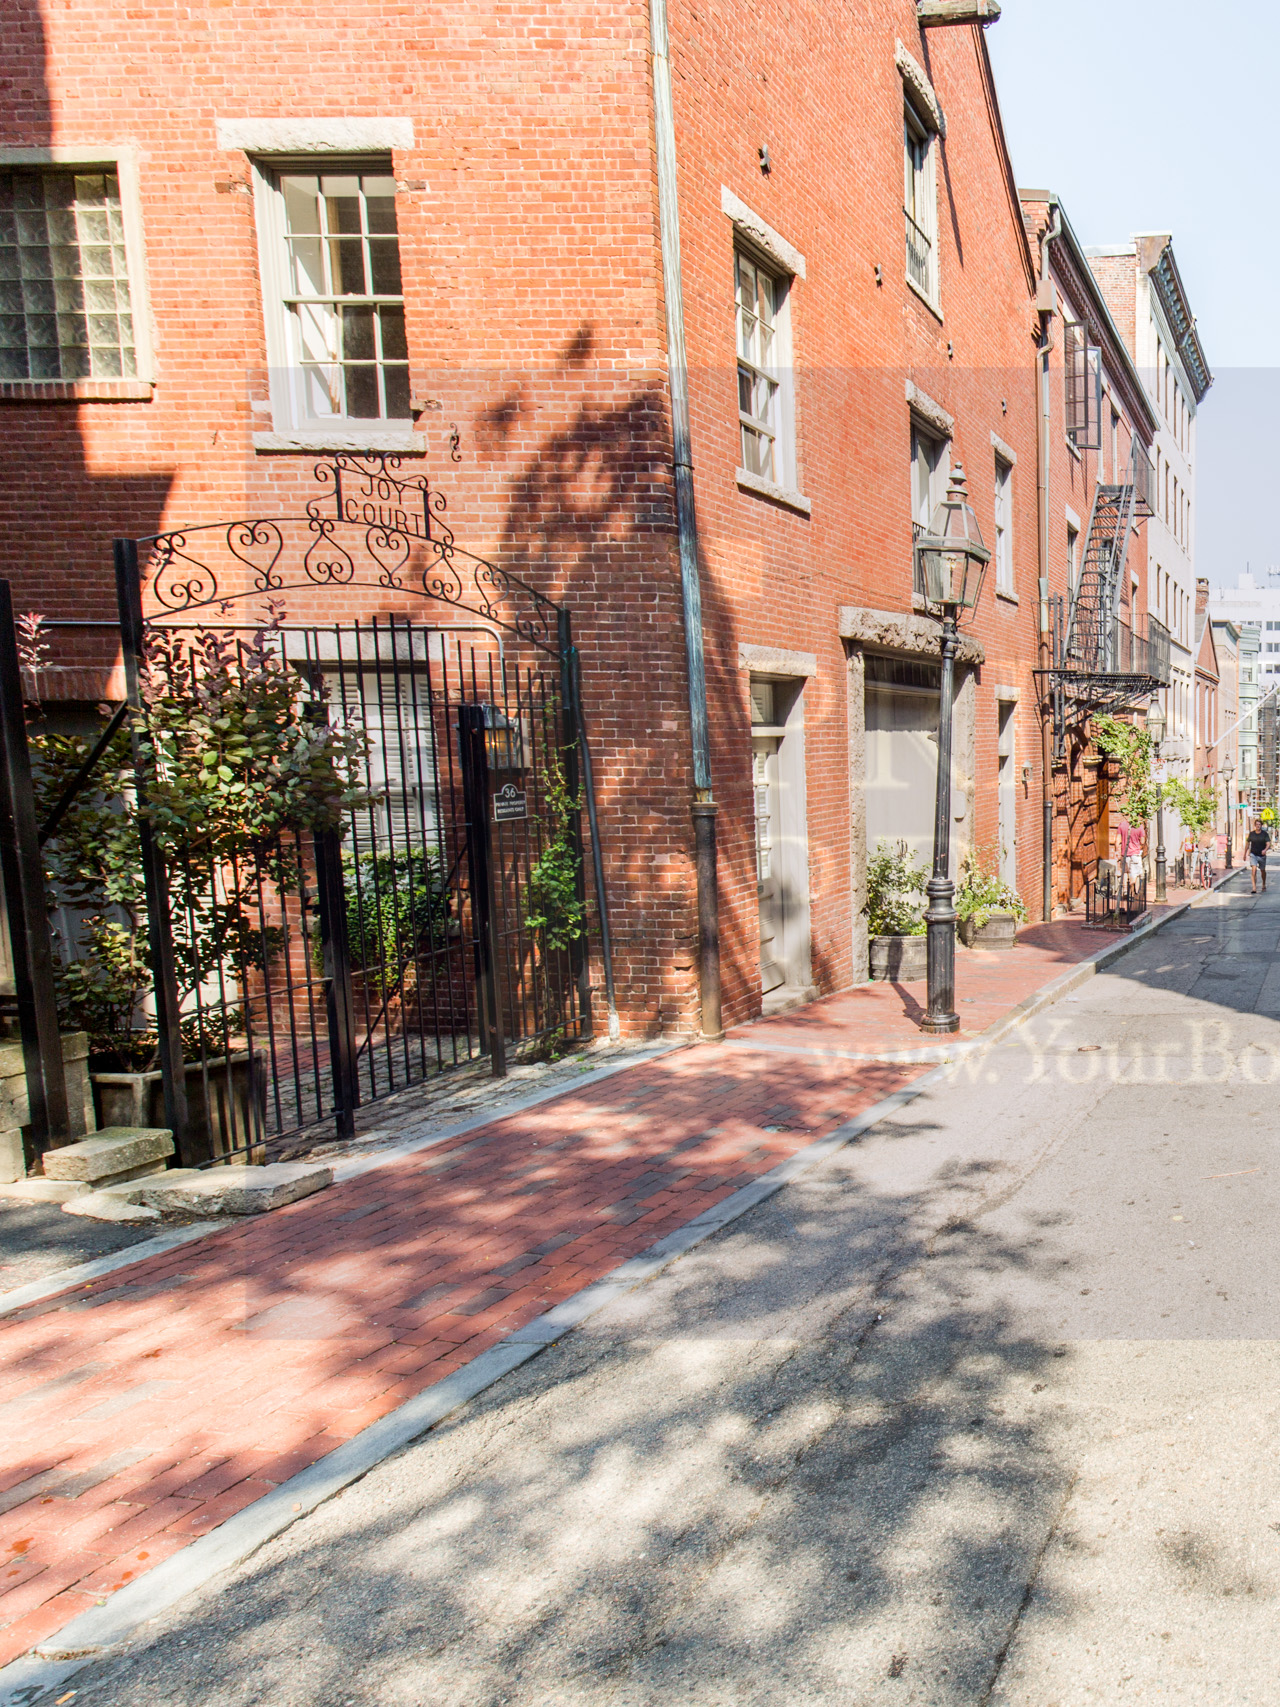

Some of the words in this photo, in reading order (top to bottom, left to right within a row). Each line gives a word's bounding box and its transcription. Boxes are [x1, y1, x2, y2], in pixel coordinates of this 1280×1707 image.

[361, 476, 406, 505] JOY
[345, 498, 423, 537] COURT
[504, 788, 516, 798] 36
